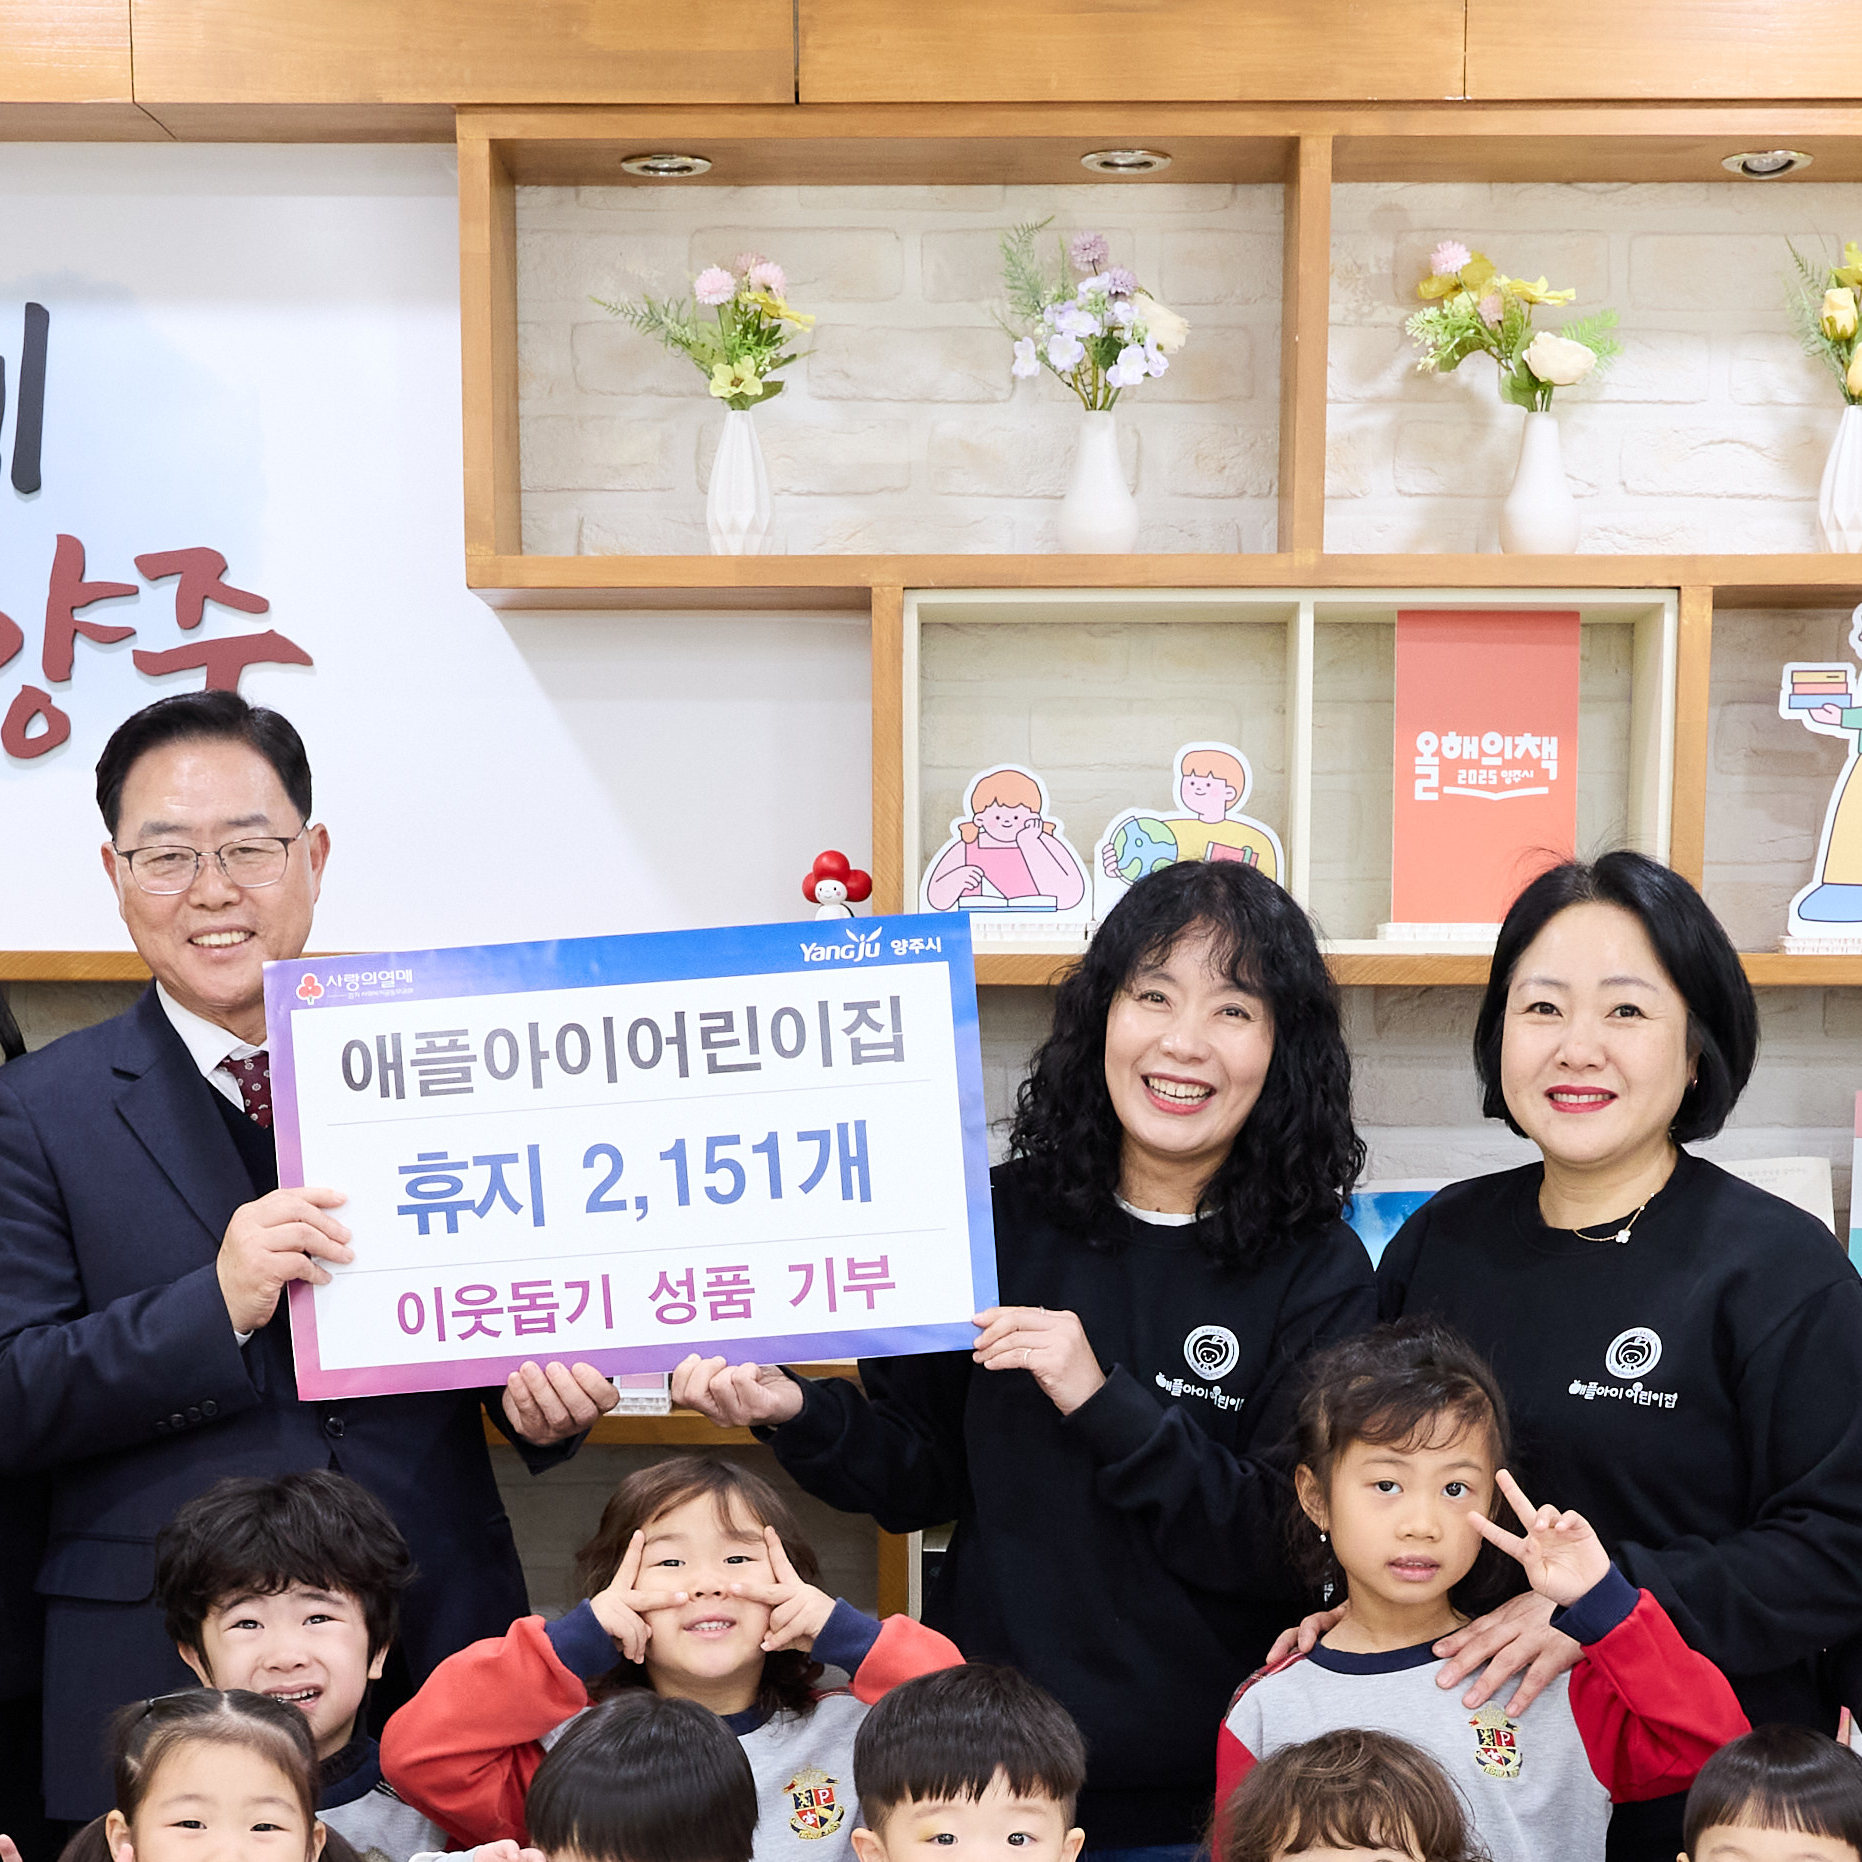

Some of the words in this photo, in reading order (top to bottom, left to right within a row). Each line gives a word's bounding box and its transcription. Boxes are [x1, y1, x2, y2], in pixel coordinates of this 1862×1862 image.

[1457, 769, 1498, 785] 2025
[1501, 769, 1535, 785] 양주시
[890, 936, 943, 957] 양주시
[326, 968, 414, 993] 사랑의열매
[341, 993, 906, 1100] 애플아이어린이집
[397, 1144, 546, 1236] 휴지
[583, 1119, 873, 1222] 2,151개
[396, 1273, 615, 1343] 이웃돕기
[649, 1264, 756, 1326] 성품
[788, 1254, 897, 1314] 기부
